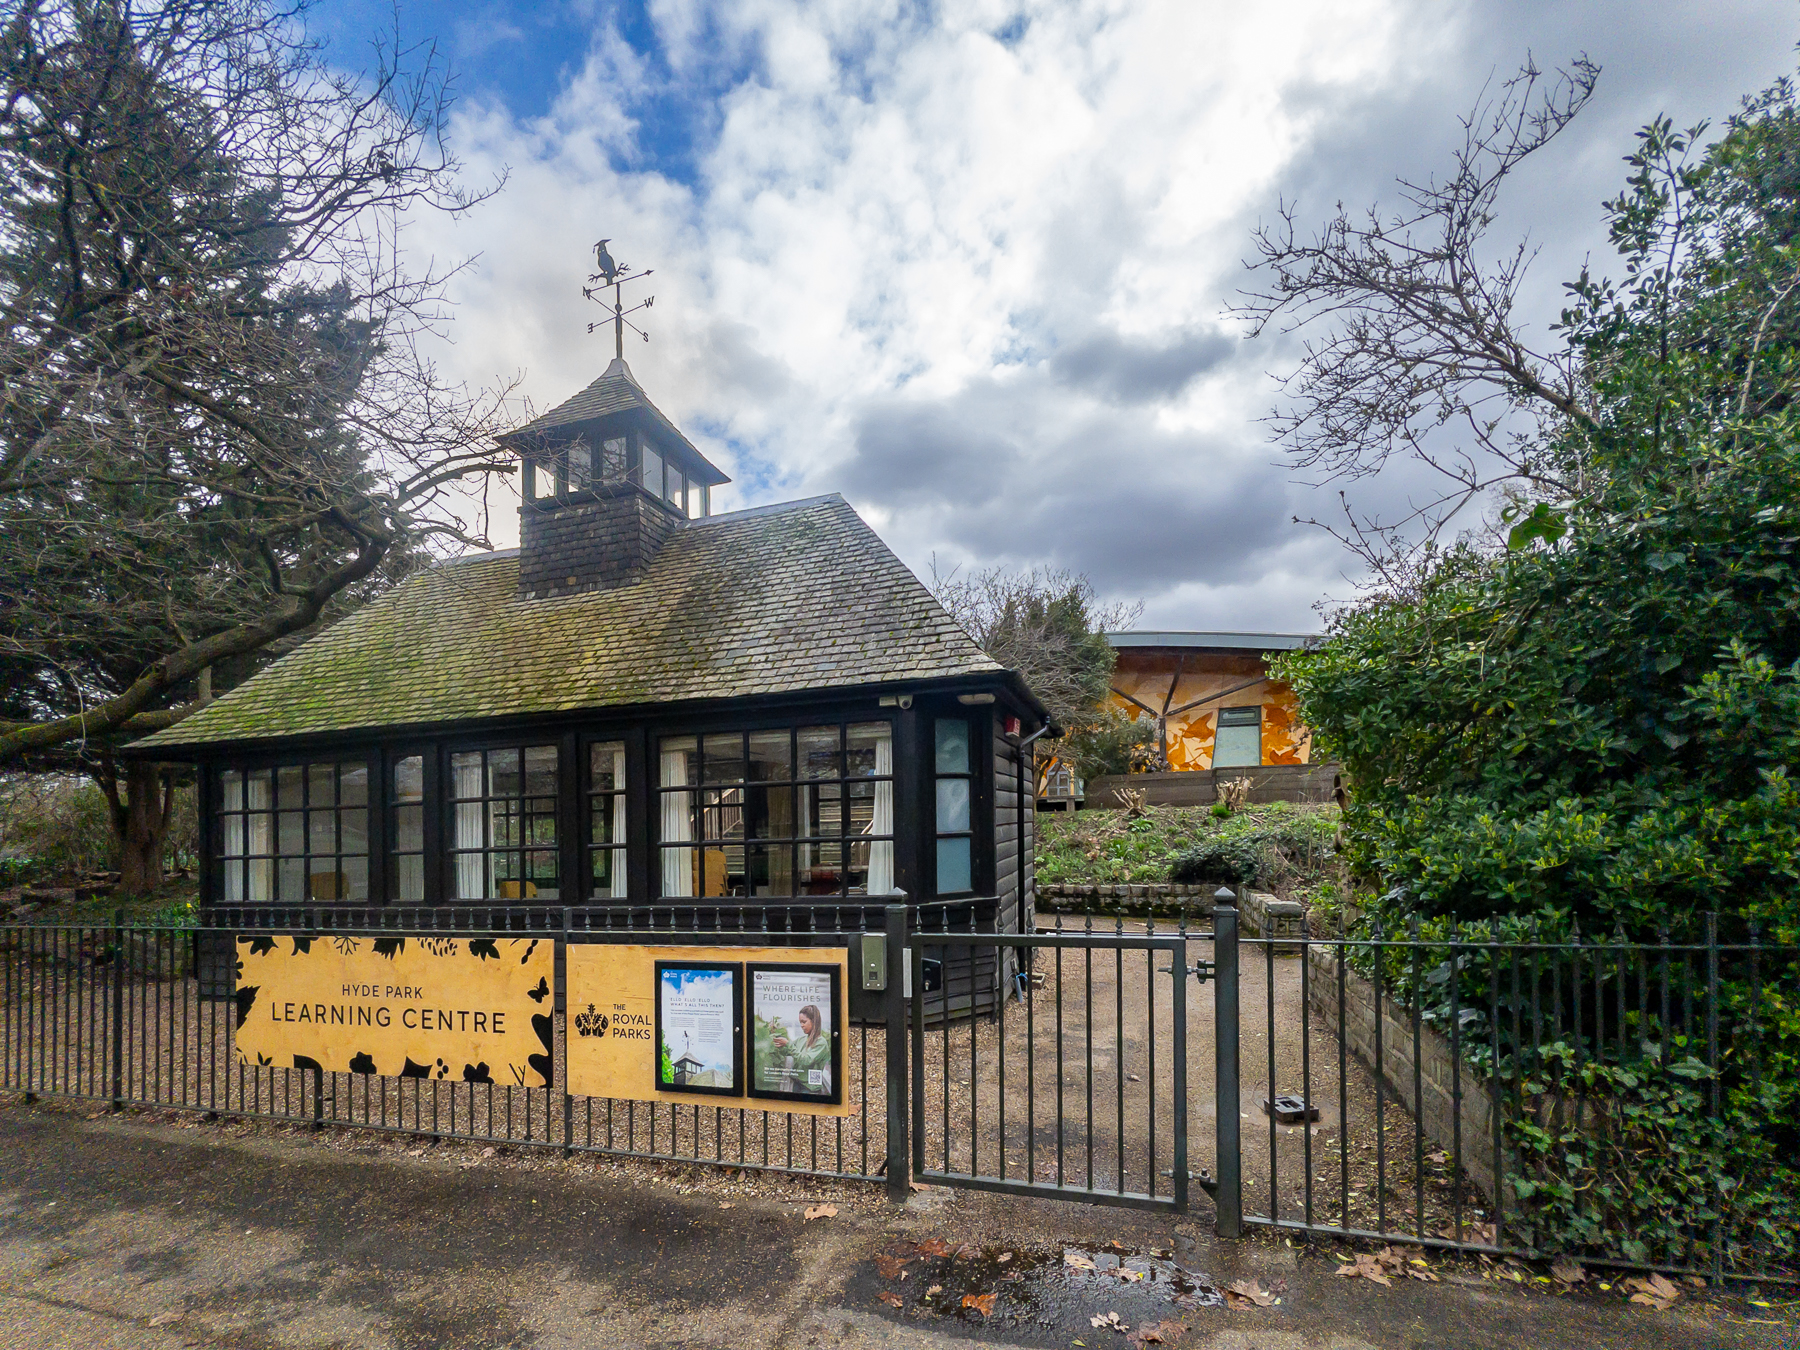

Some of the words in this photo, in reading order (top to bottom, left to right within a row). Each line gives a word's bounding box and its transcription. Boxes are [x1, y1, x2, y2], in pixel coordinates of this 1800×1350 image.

[644, 296, 655, 308] W
[643, 332, 649, 342] S
[342, 984, 380, 997] HYDE
[386, 985, 423, 999] PARK
[763, 985, 796, 993] WHERE
[800, 986, 820, 994] LIFE
[763, 993, 821, 1002] FLOURISHES
[613, 1003, 626, 1011] THE
[272, 1002, 391, 1027] LEARNING
[402, 1008, 506, 1034] CENTRE
[613, 1013, 652, 1026] ROYAL
[613, 1027, 651, 1040] PARKS
